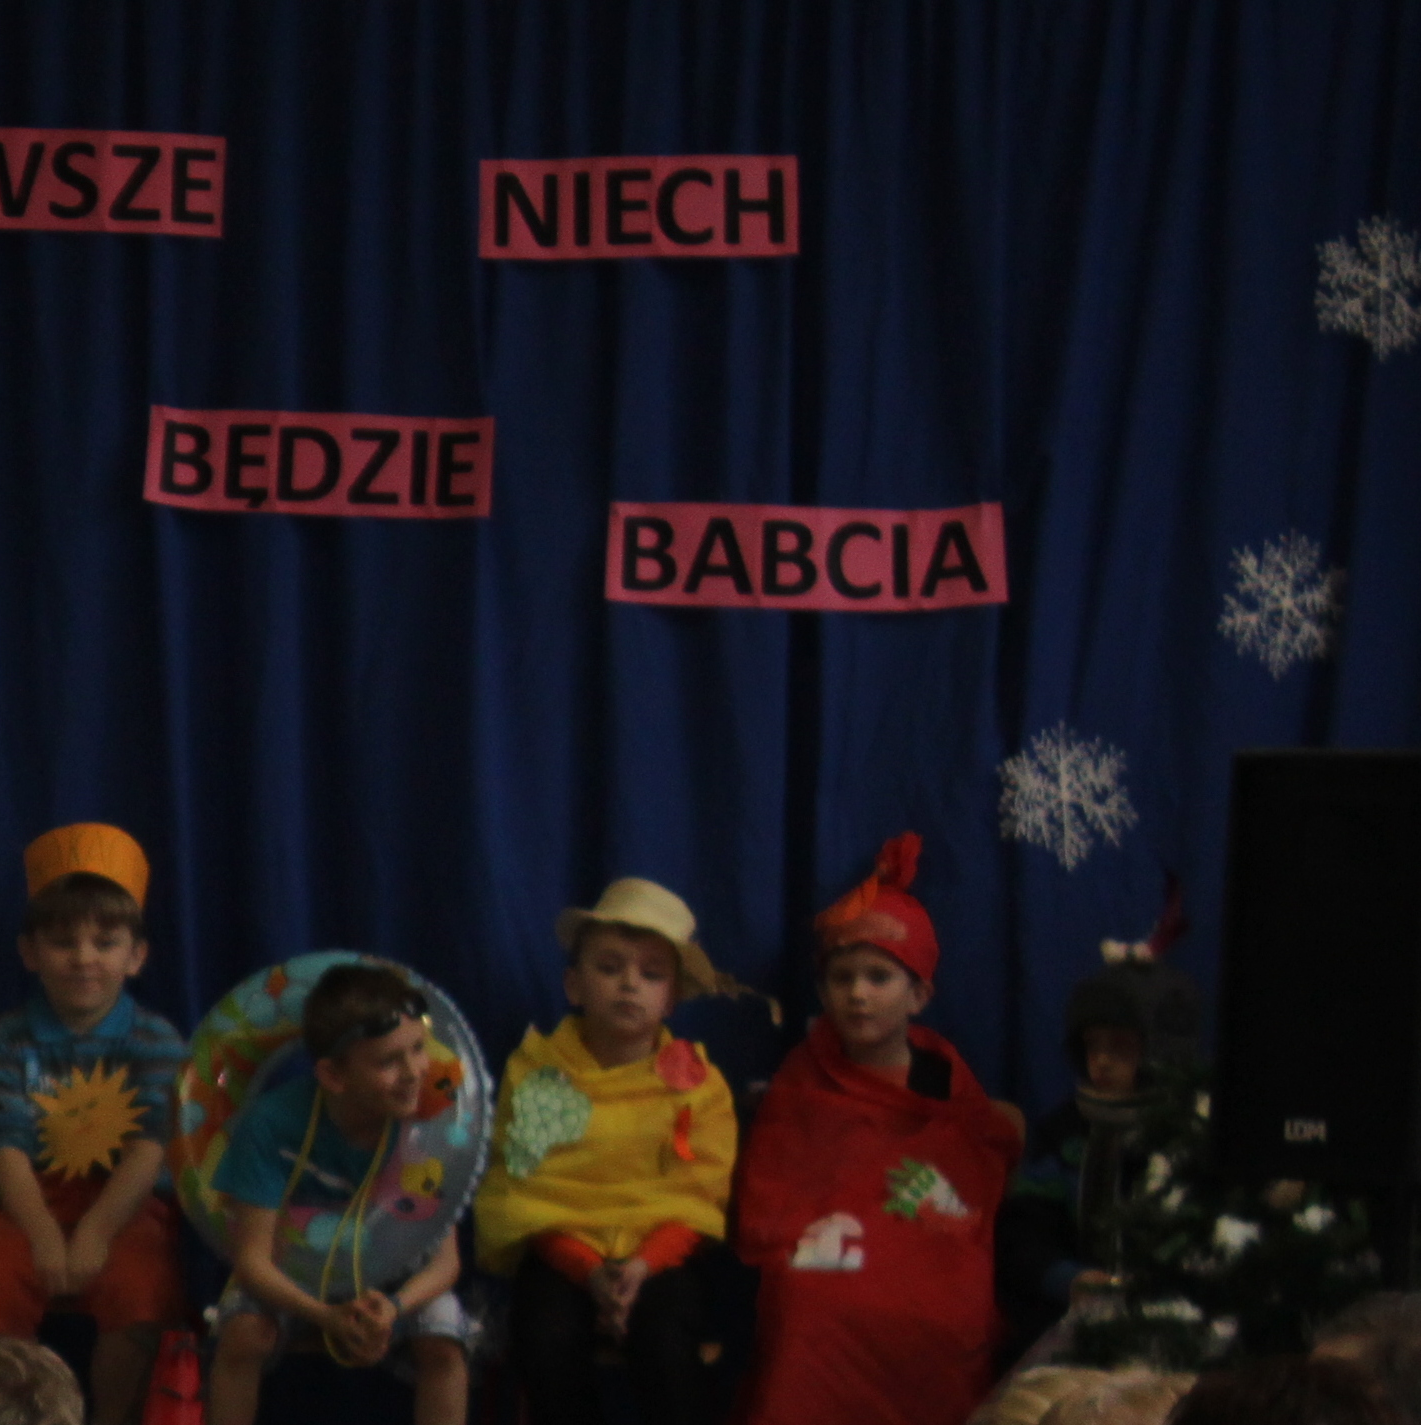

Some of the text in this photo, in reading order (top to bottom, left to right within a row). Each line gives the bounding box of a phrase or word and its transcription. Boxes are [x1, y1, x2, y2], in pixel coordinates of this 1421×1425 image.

[491, 168, 787, 248] NIECH
[158, 422, 482, 507] BĘDZIE
[620, 517, 989, 599] BABCIA
